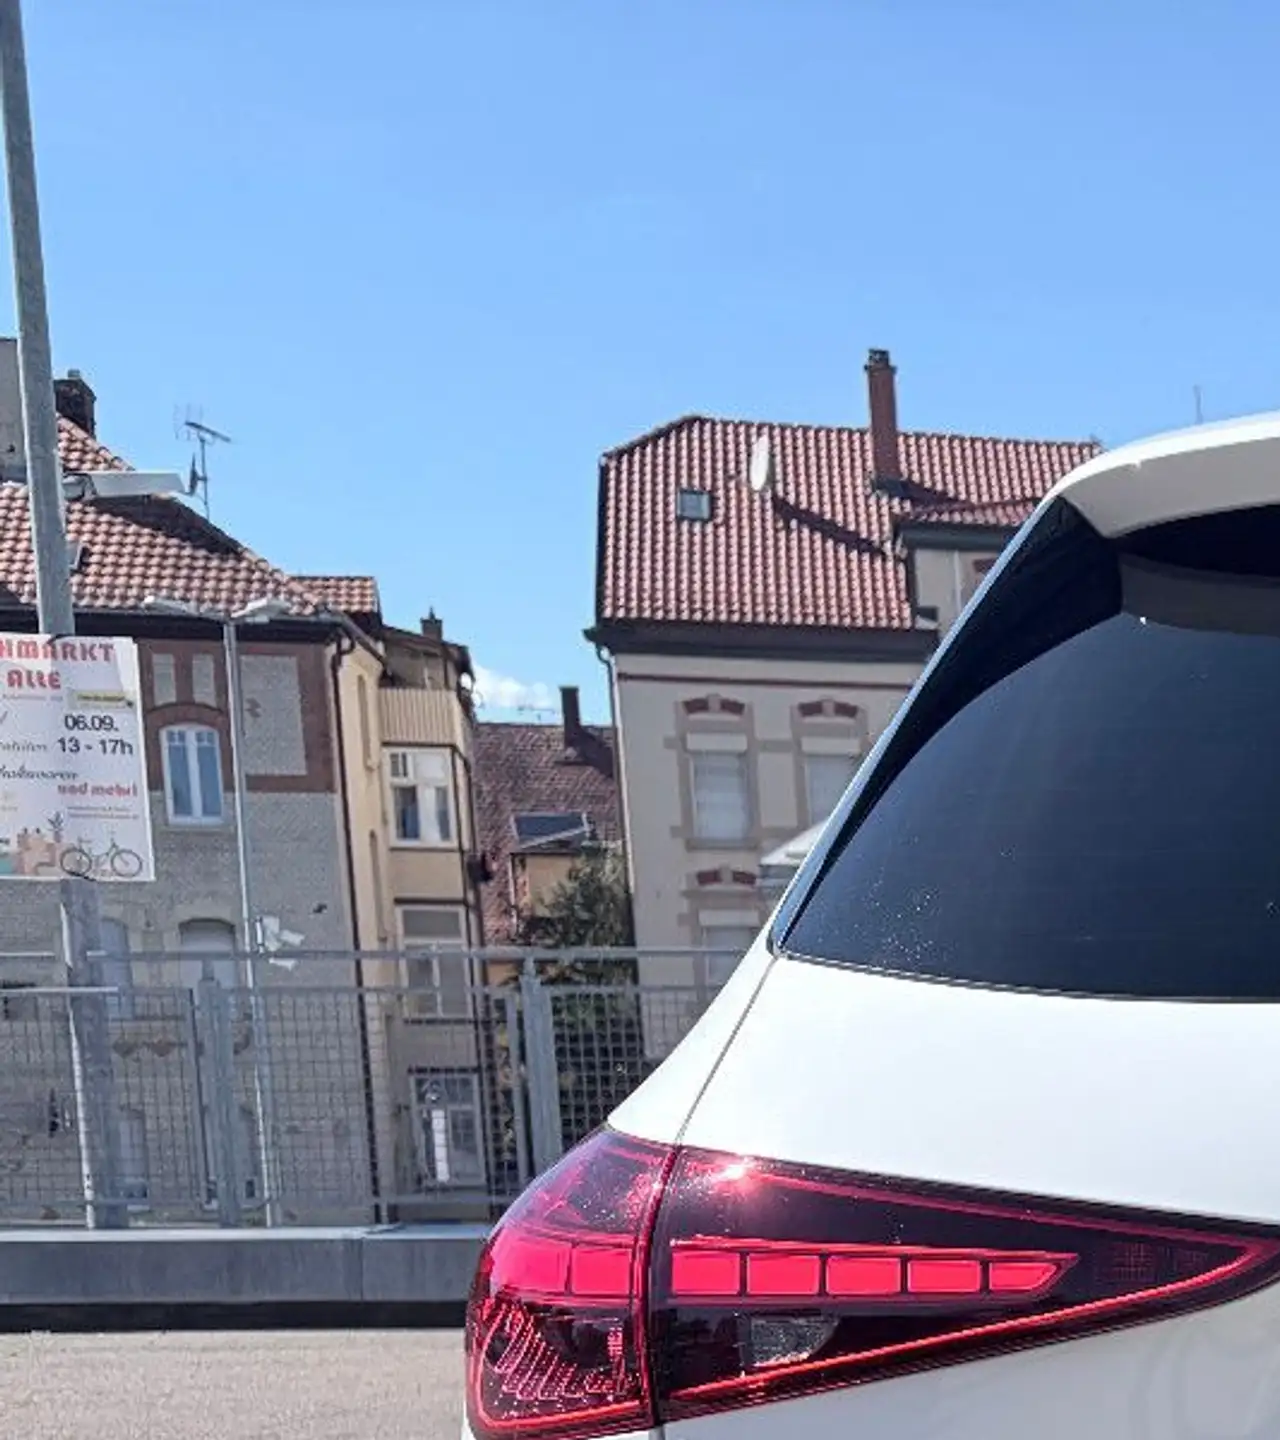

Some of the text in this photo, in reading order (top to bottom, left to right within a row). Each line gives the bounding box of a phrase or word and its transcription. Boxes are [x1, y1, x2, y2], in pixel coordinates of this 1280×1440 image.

[64, 714, 119, 732] 06.09.
[57, 736, 80, 753] 13
[99, 738, 134, 755] 17h
